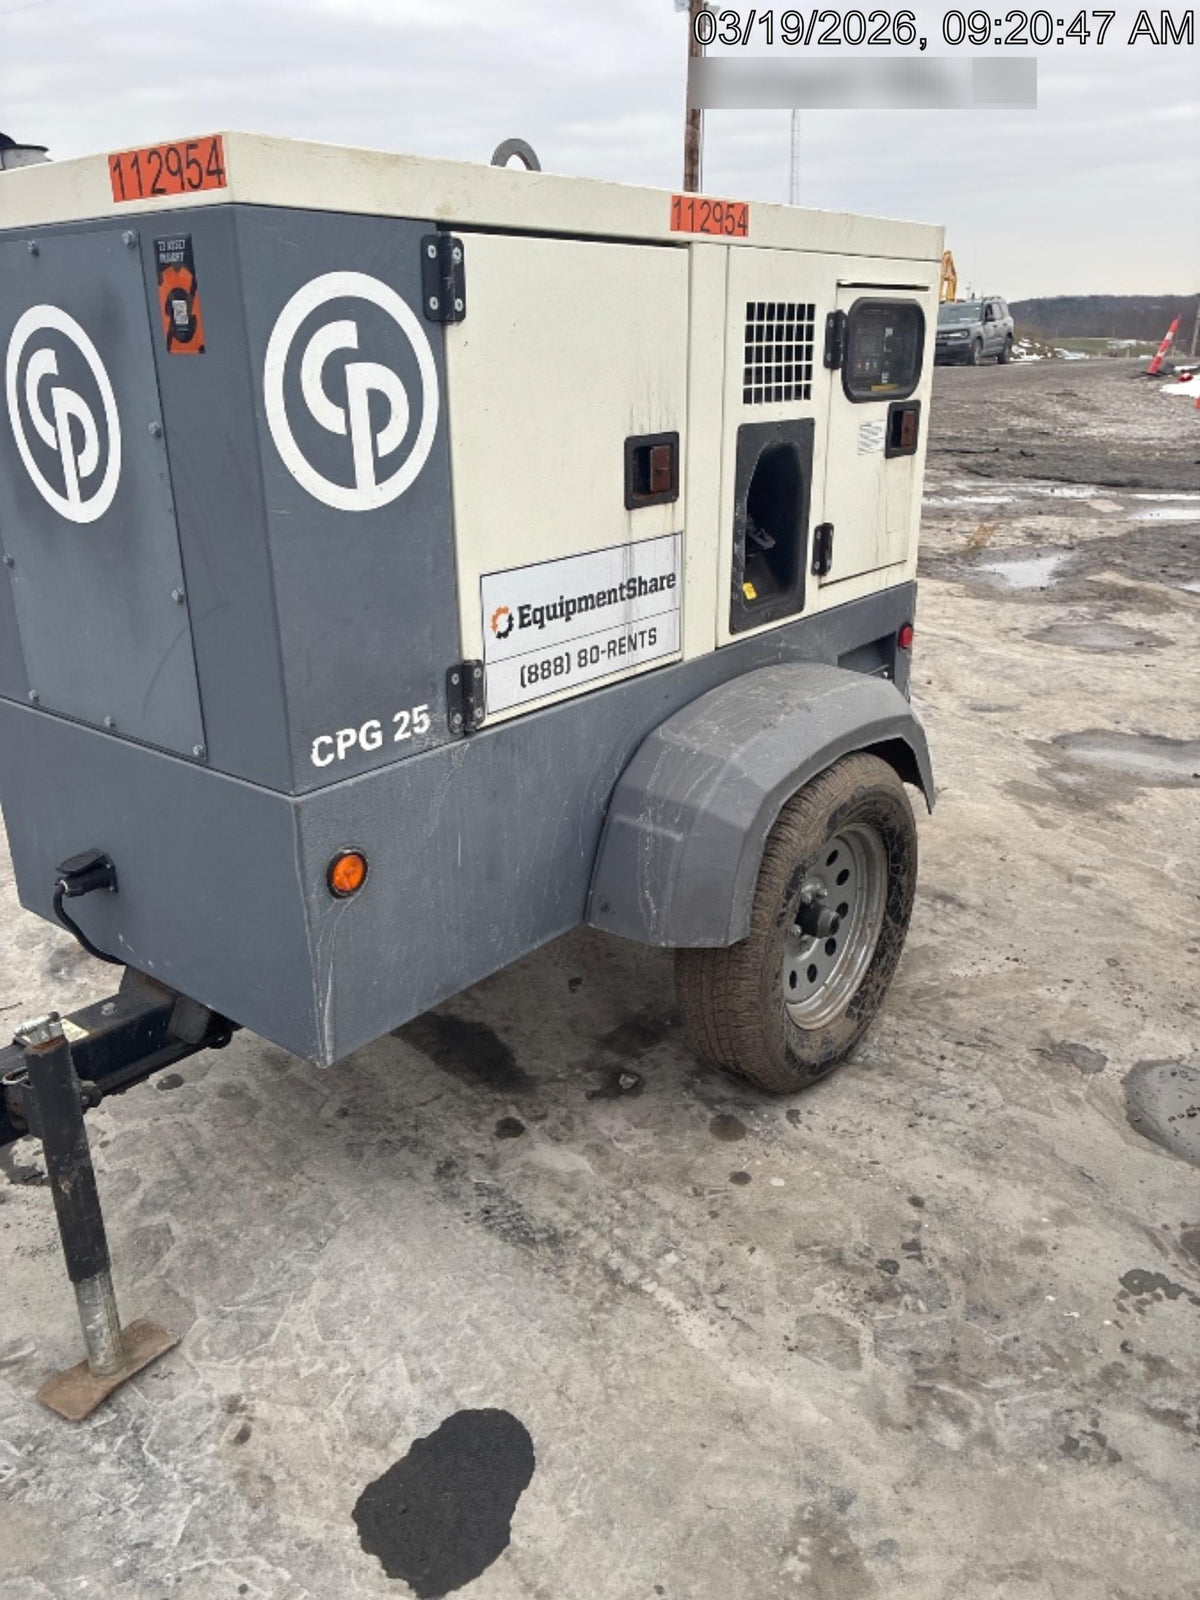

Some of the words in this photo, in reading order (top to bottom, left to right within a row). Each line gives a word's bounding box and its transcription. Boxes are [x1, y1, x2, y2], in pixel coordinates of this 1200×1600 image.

[113, 138, 225, 200] 112954
[673, 198, 748, 236] 112954
[517, 572, 677, 629] EquipmentShare
[520, 651, 572, 688] (888)
[577, 627, 657, 668] 80-RENTS
[311, 719, 383, 767] CPG
[392, 703, 431, 742] 25
